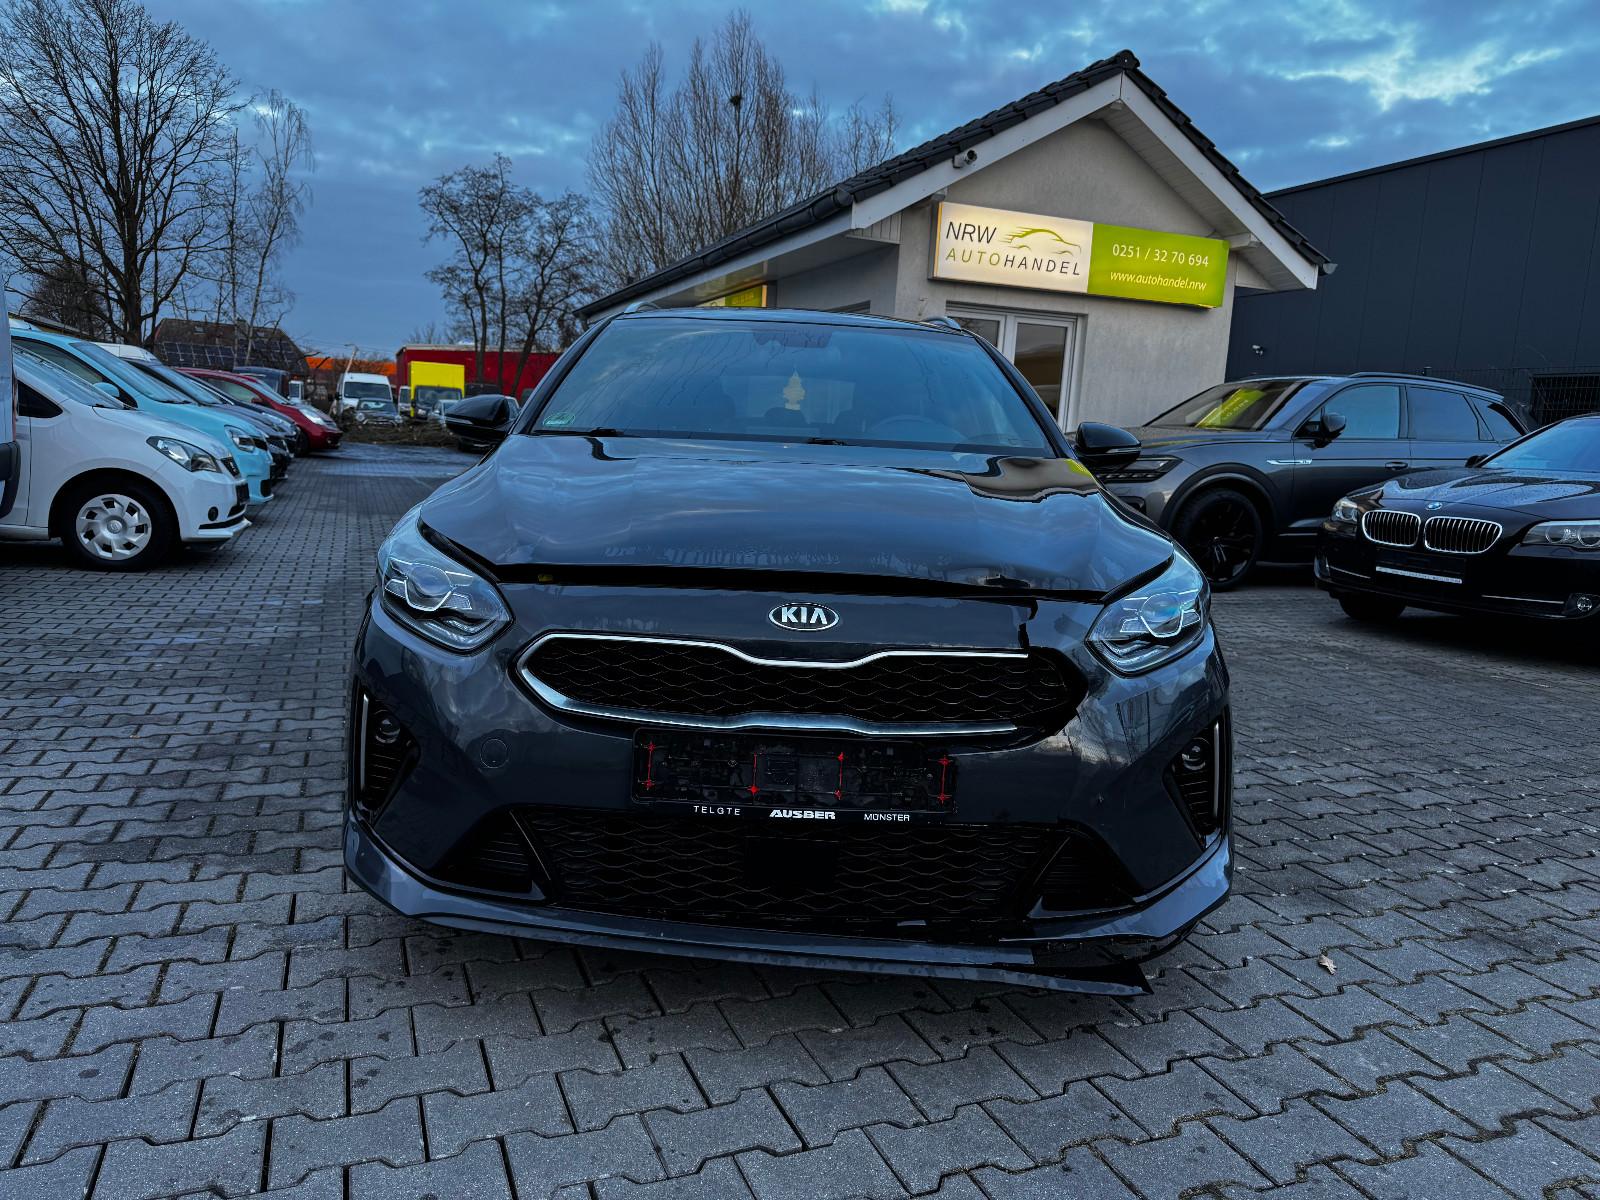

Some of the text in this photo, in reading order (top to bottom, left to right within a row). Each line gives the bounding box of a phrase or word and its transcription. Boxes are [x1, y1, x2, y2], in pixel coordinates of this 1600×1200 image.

[946, 221, 997, 244] NRW
[945, 247, 1081, 276] AUTOHANDEL
[1112, 244, 1209, 267] 0251 / 32 70 694
[1110, 271, 1207, 291] www.autohandel.nrw
[781, 606, 828, 625] KIA
[693, 805, 741, 816] TELGTE
[769, 809, 836, 820] AUSBER
